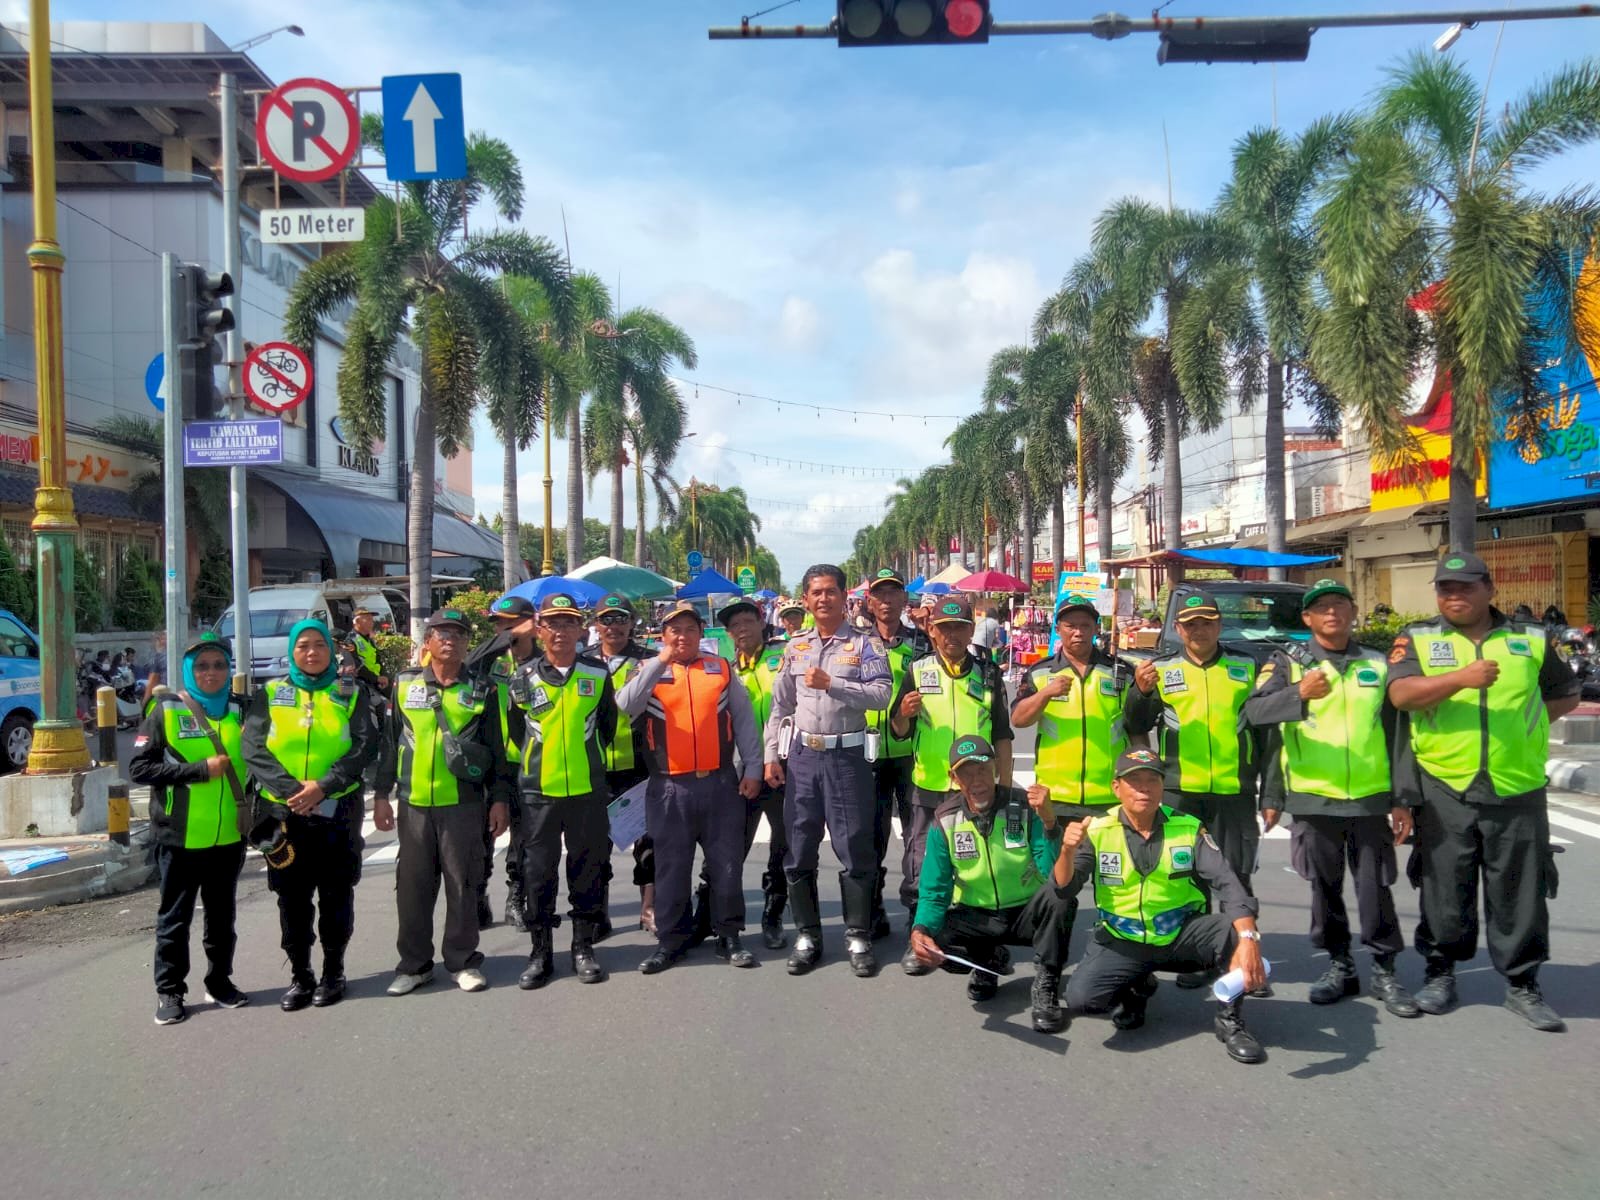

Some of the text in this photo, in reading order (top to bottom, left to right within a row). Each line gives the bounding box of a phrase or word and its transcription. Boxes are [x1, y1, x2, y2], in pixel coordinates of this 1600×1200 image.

[292, 101, 325, 162] P
[270, 214, 355, 236] 50 Meter
[210, 425, 257, 437] KAWASAN
[190, 435, 278, 449] TERTIB LALU LINTAS
[1432, 642, 1451, 652] 24
[922, 671, 937, 680] 24
[1166, 670, 1181, 679] 24
[956, 833, 973, 844] 24
[1101, 854, 1120, 866] 24
